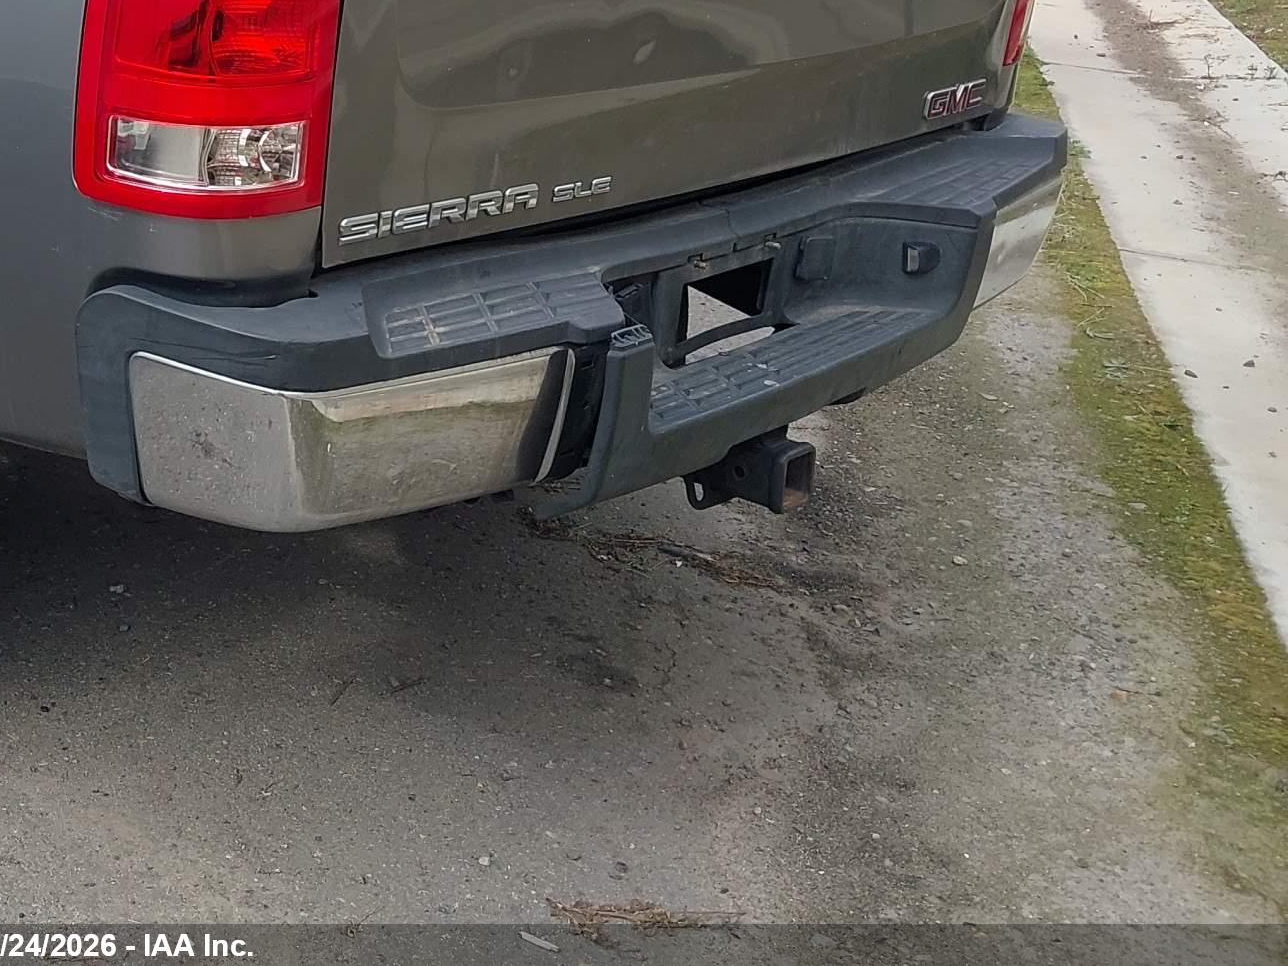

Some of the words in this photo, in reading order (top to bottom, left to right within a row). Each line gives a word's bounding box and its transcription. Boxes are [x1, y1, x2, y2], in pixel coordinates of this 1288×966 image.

[925, 78, 987, 120] GMC
[339, 183, 539, 246] SIERRA
[552, 176, 612, 203] SLE
